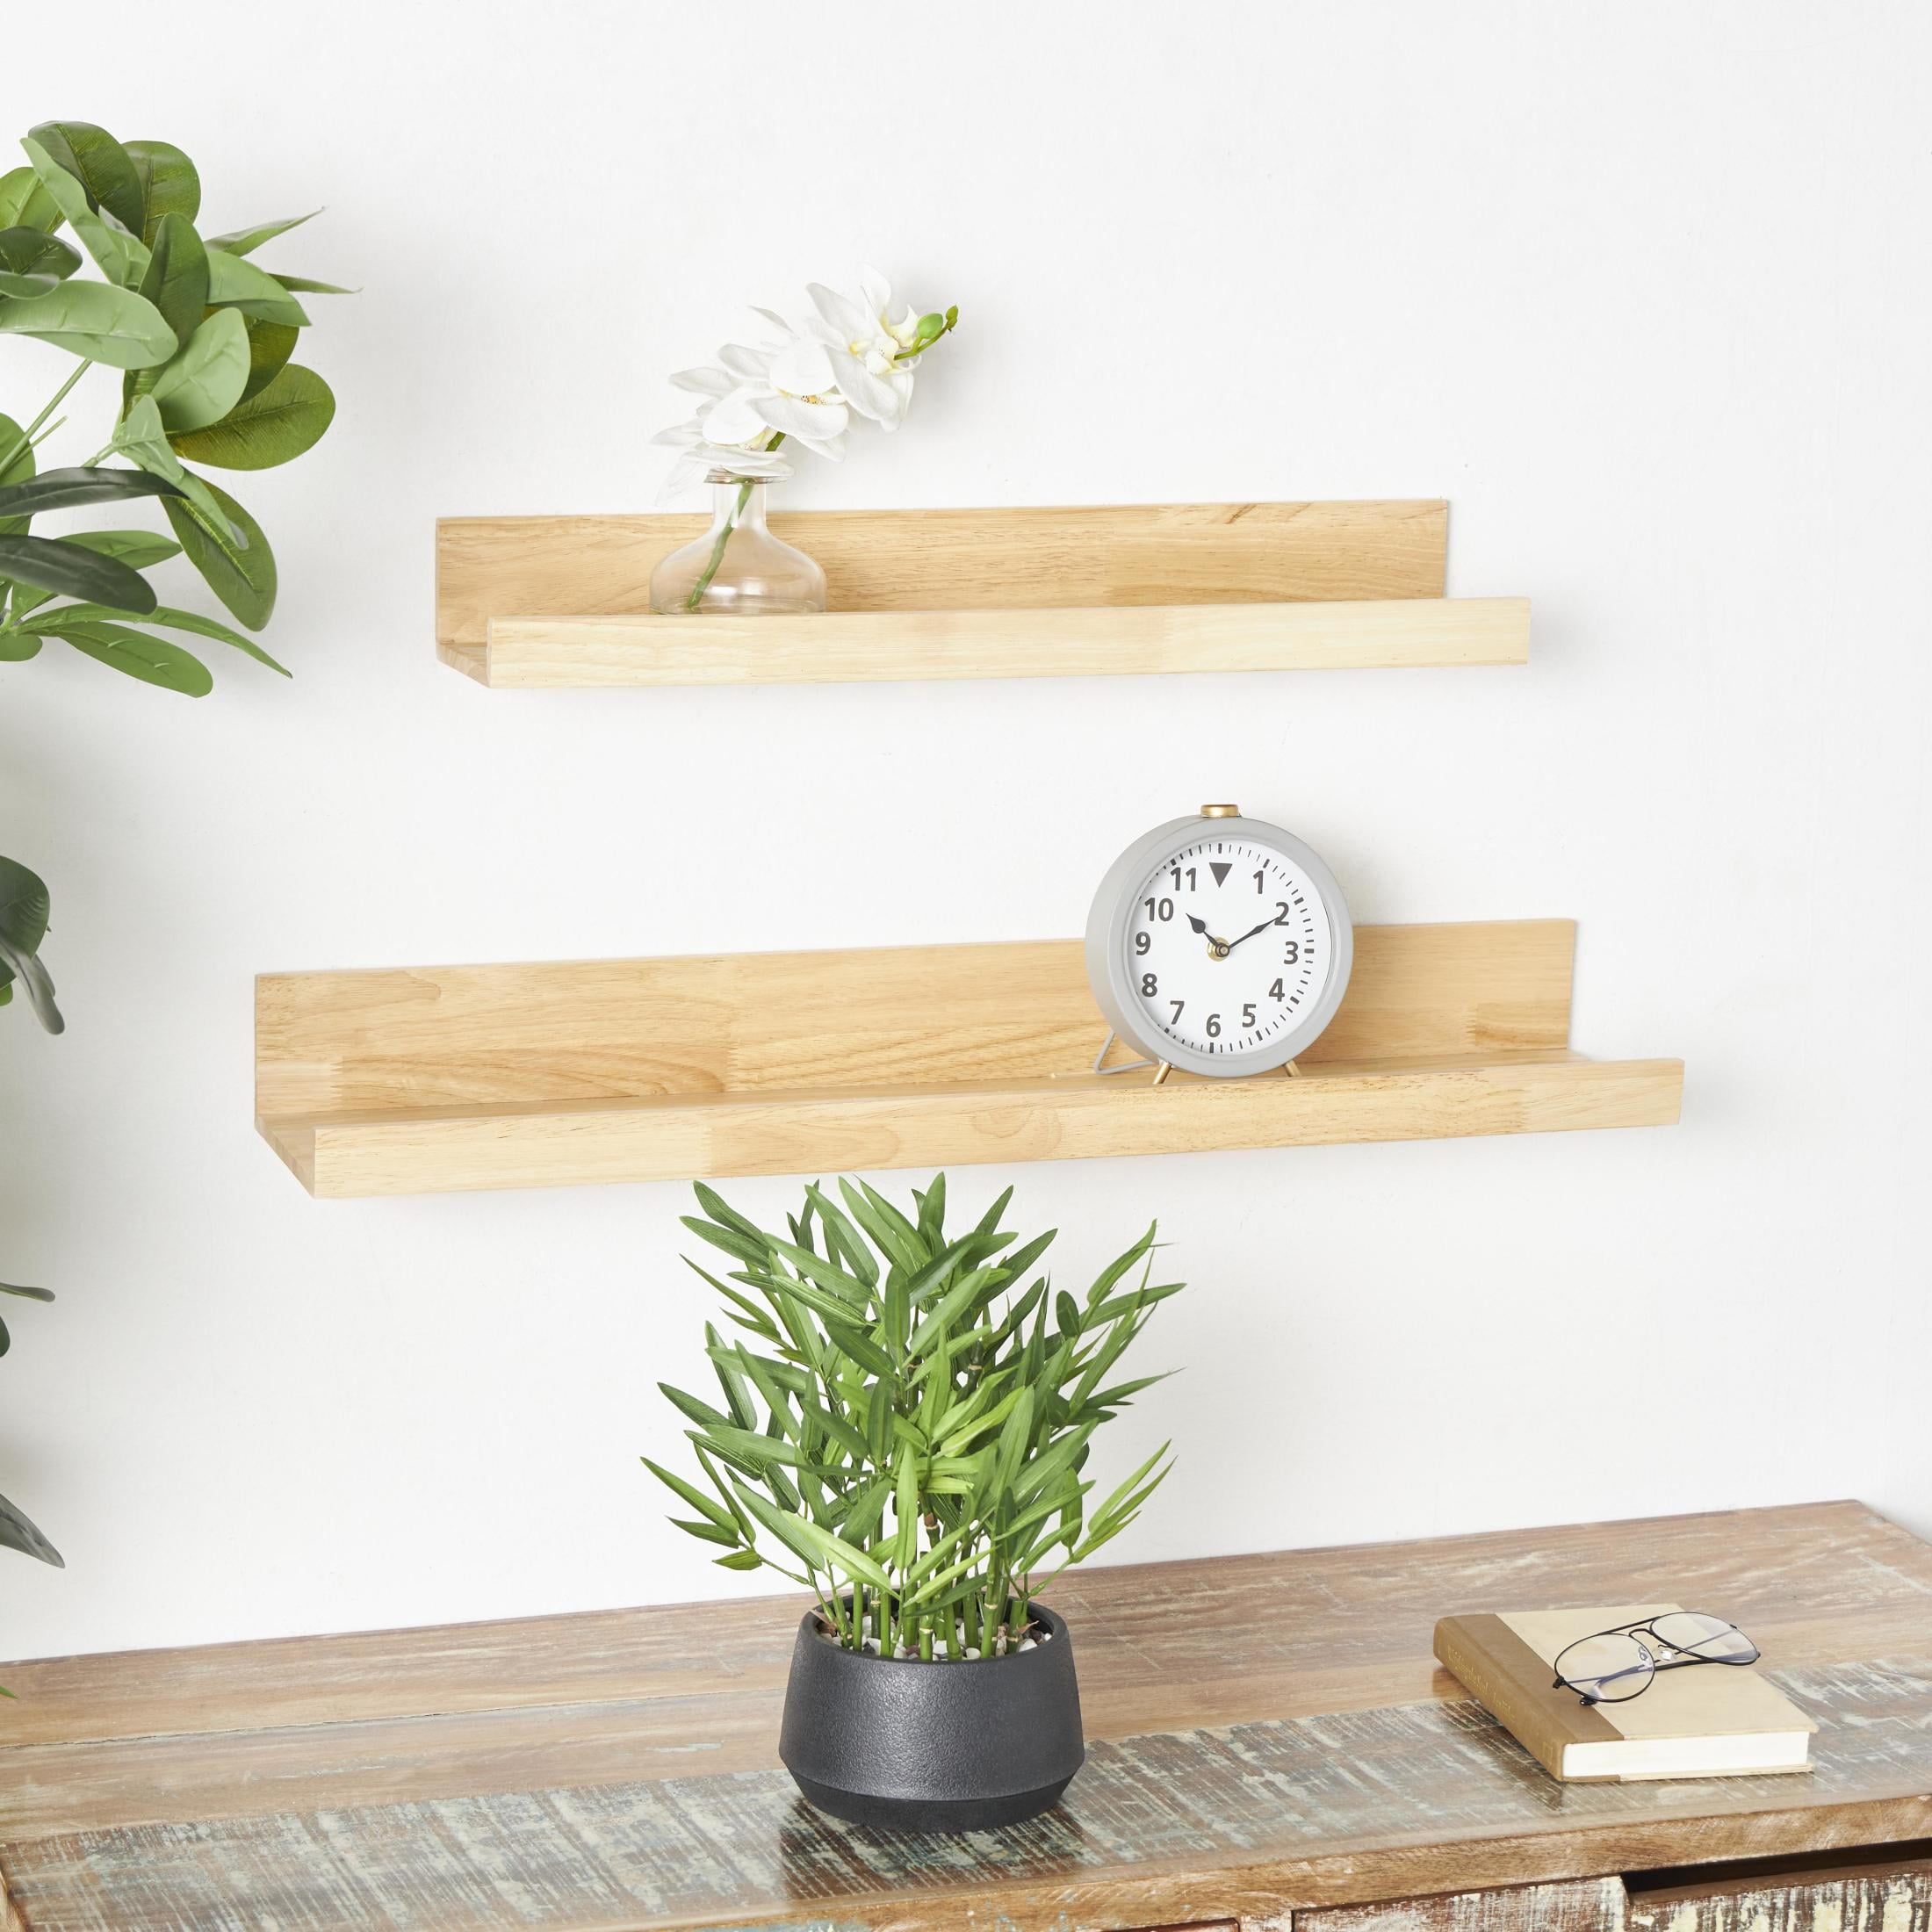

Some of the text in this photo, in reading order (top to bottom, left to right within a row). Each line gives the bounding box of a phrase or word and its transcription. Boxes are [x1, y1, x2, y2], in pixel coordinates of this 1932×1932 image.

[1170, 867, 1197, 891] 11
[1252, 869, 1264, 895] 1
[1143, 898, 1174, 922] 10
[1273, 902, 1290, 926] 2
[1135, 931, 1151, 956] 9
[1283, 941, 1299, 965] 3
[1141, 972, 1158, 998] 8
[1268, 977, 1286, 1003] 4
[1170, 1000, 1185, 1026] 7
[1206, 1013, 1222, 1038] 6
[1242, 1003, 1257, 1028] 5
